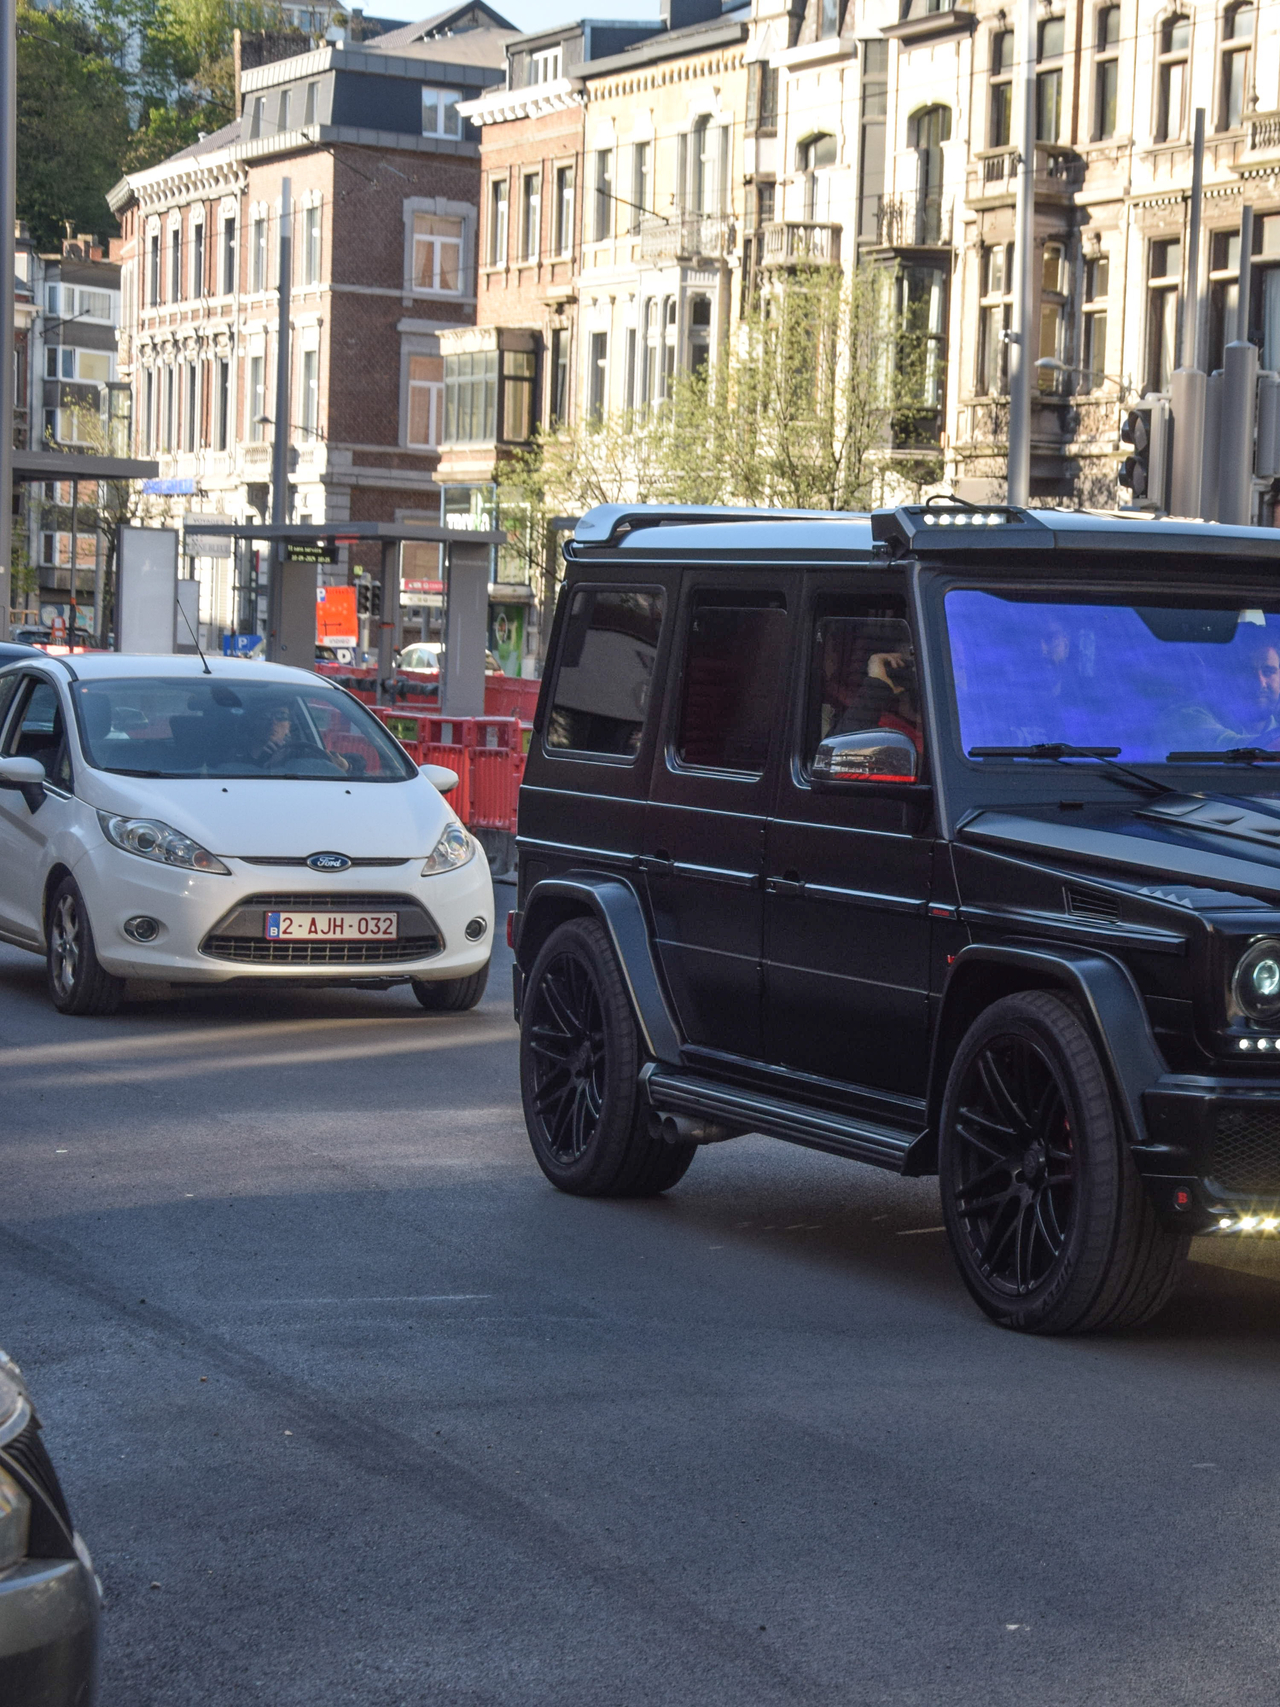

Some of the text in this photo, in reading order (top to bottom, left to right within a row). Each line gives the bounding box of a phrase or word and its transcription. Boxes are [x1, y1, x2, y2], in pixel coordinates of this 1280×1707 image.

[238, 638, 248, 649] P
[317, 856, 342, 868] Ford
[270, 917, 394, 937] B 2-AJH-032
